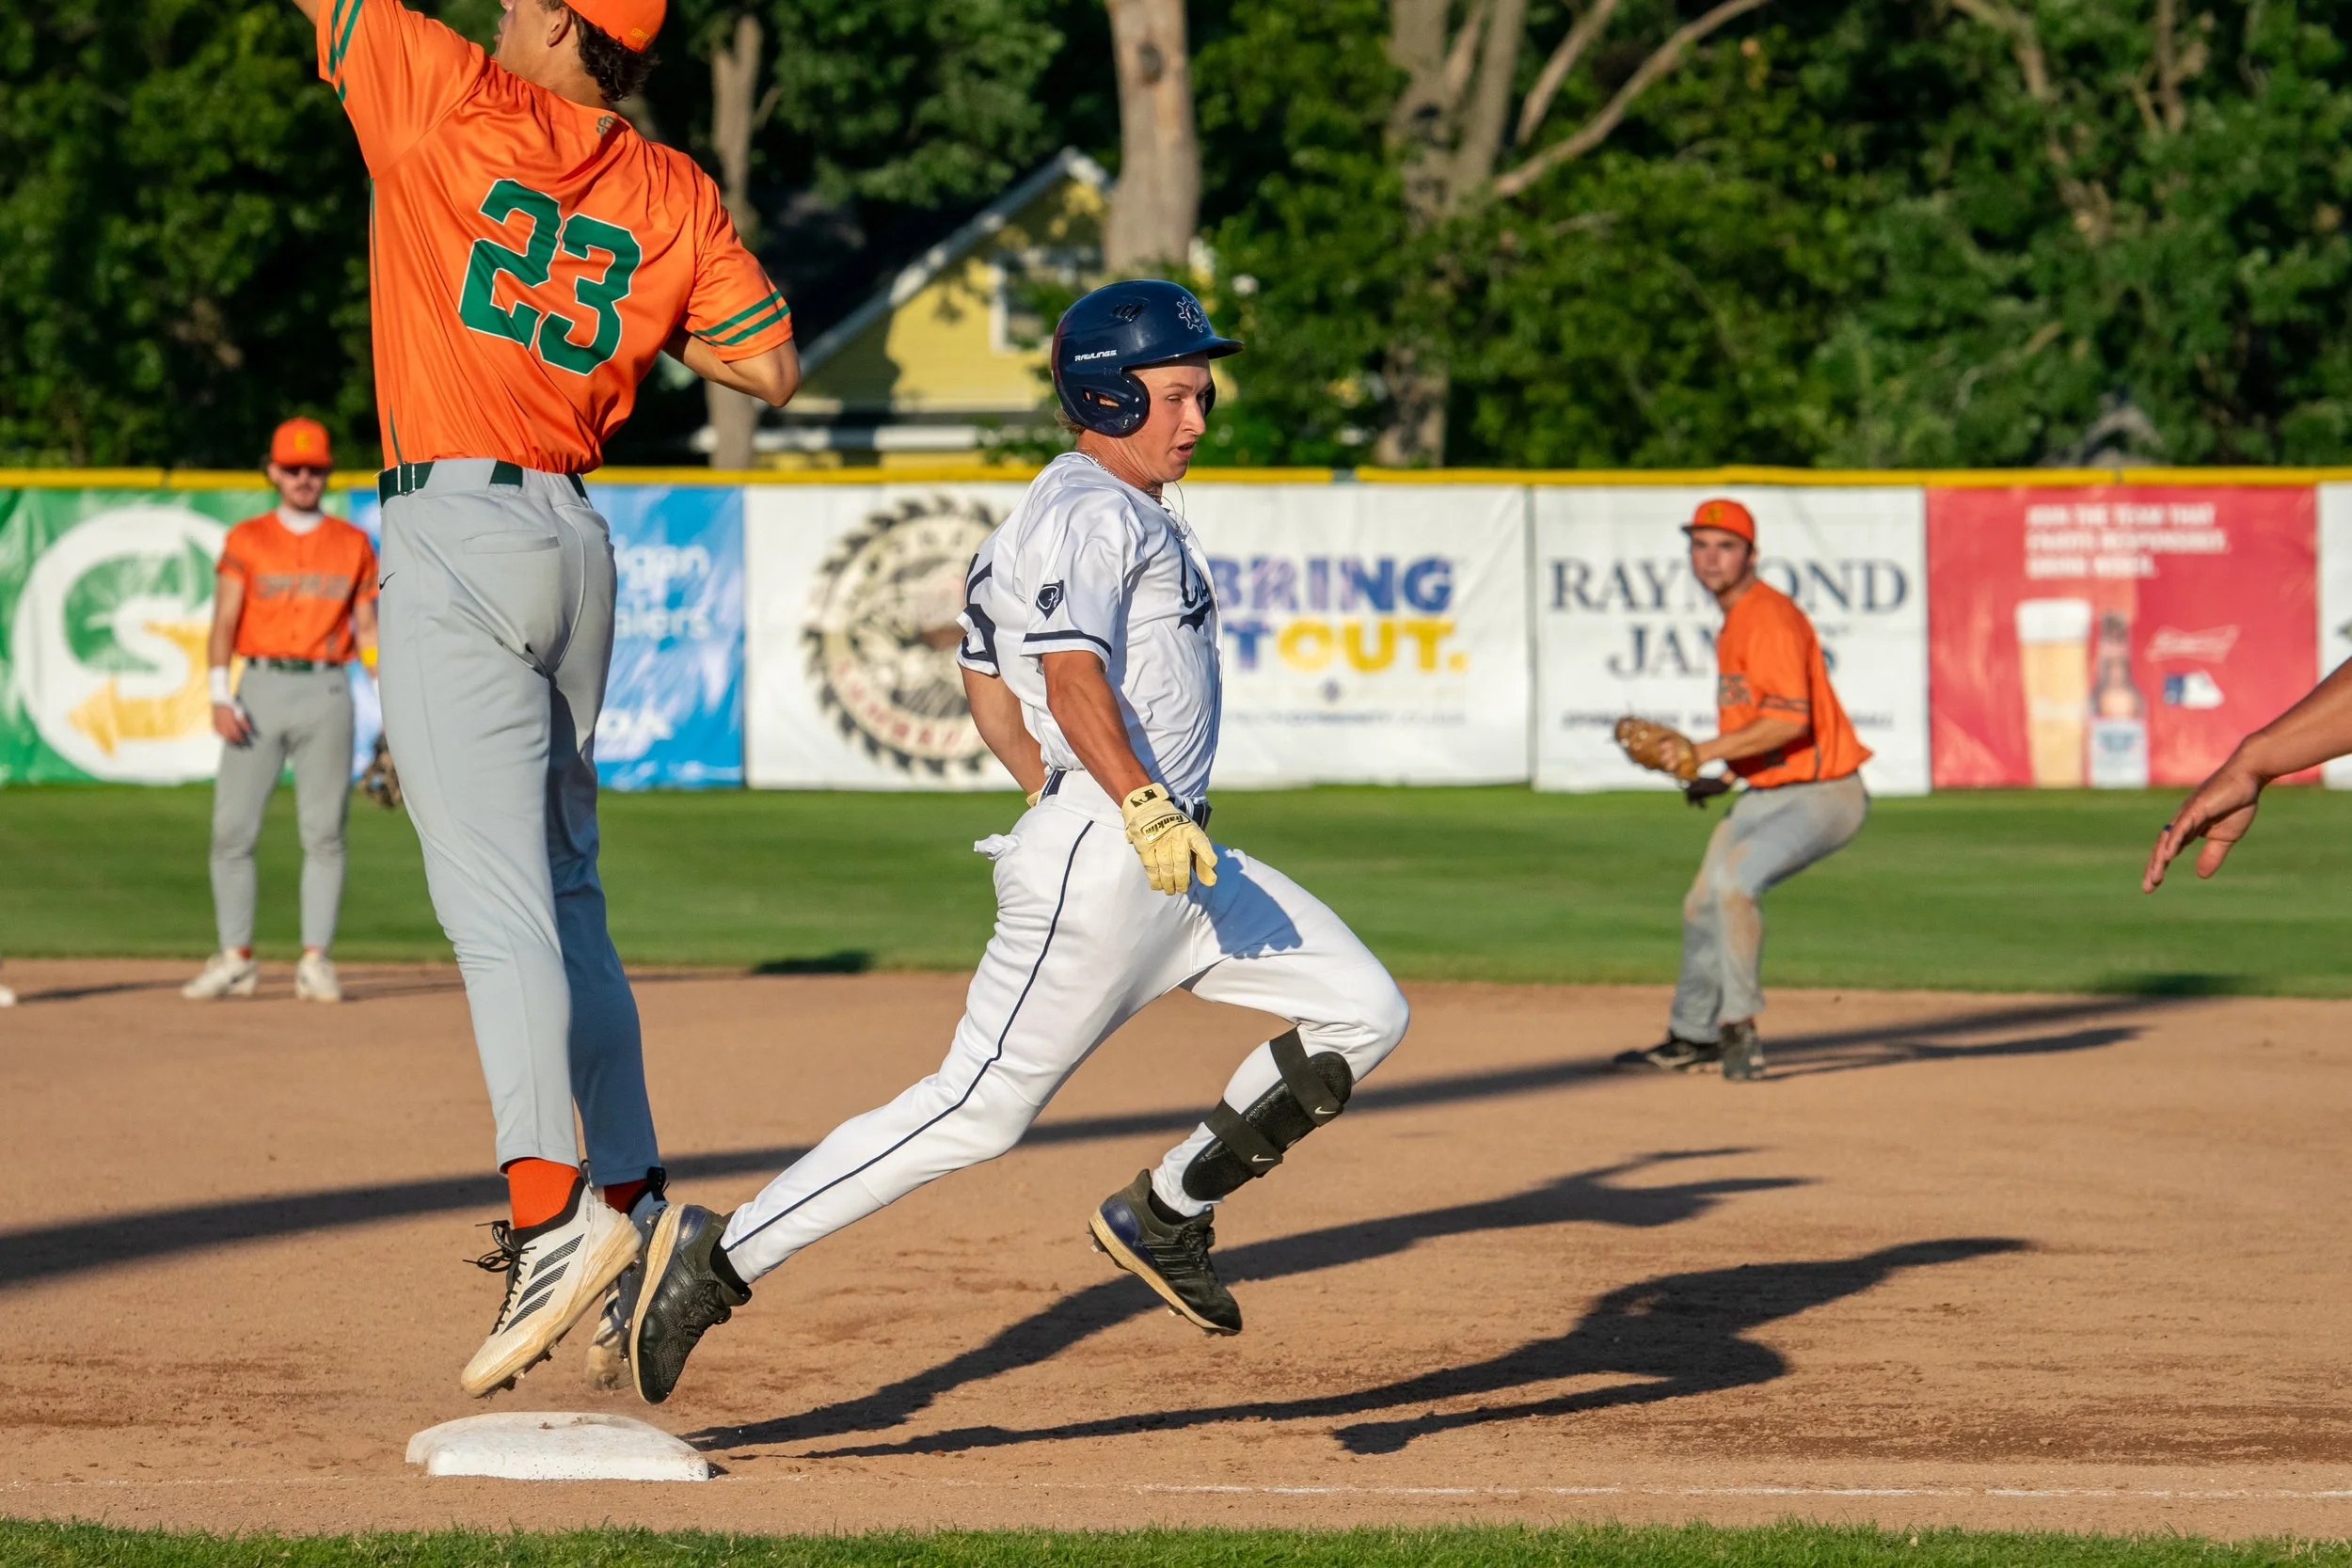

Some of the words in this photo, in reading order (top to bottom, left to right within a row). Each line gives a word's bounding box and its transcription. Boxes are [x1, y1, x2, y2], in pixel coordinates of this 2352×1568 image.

[459, 178, 643, 376] 23
[1074, 349, 1118, 362] RAWLINGS
[1205, 554, 1454, 614] BRING
[1224, 620, 1272, 673] T
[1277, 617, 1469, 673] OUT.
[1144, 815, 1184, 836] Franklin
